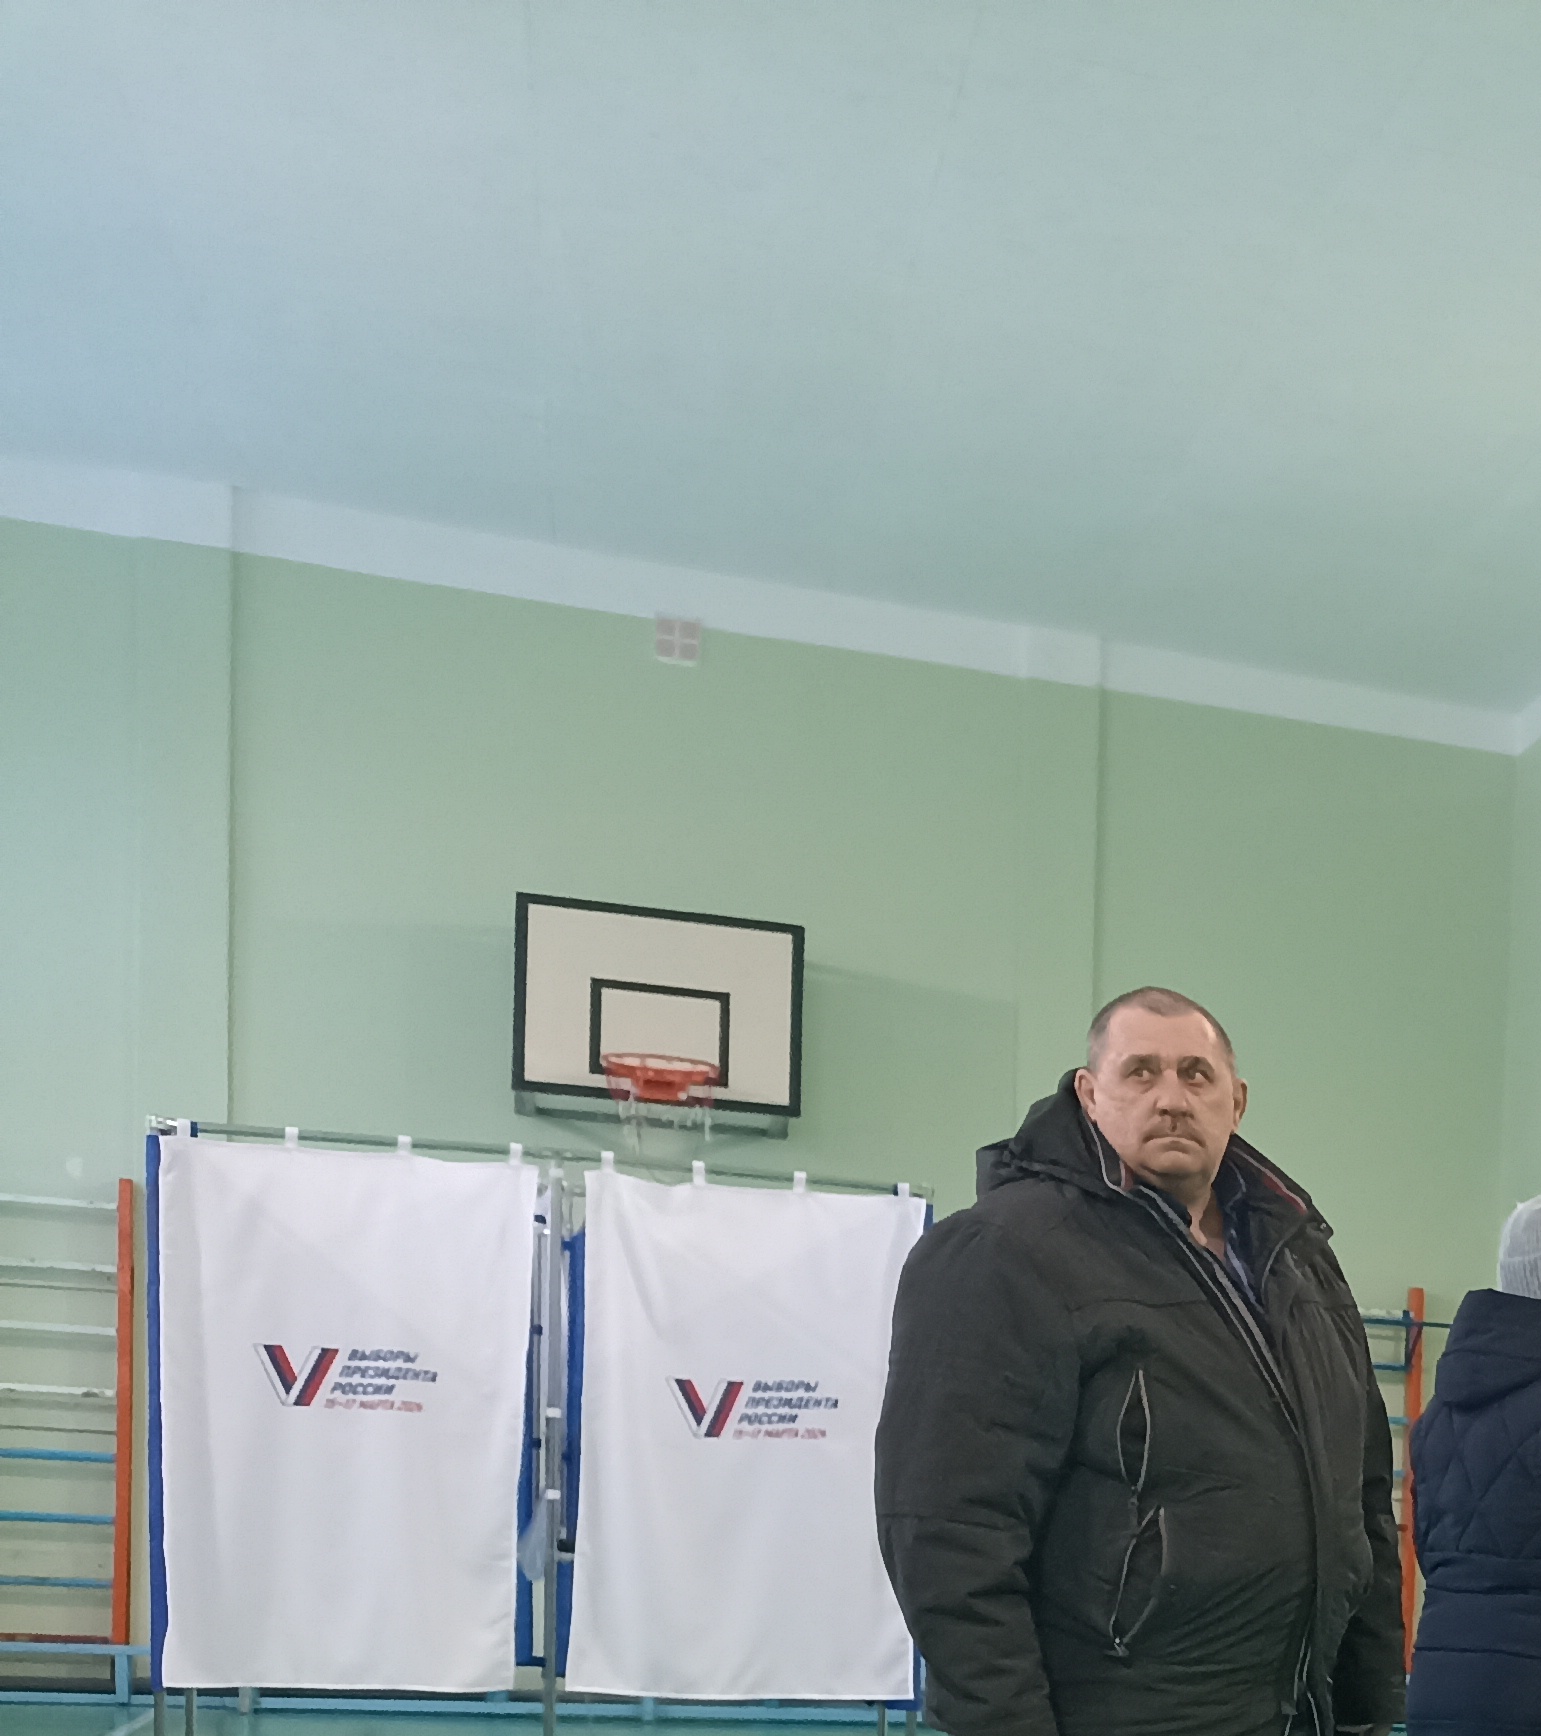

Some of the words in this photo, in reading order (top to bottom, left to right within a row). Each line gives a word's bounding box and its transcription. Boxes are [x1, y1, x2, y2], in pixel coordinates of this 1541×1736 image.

[347, 1348, 420, 1364] ВЫБОРЫ
[338, 1365, 438, 1383] ПРЕЗИДЕНТА
[329, 1381, 396, 1396] РОССИИ
[751, 1379, 819, 1393] ВЫБОРЫ
[744, 1396, 839, 1410] ПРЕЗИДЕНТА
[737, 1412, 799, 1426] РОССИИ
